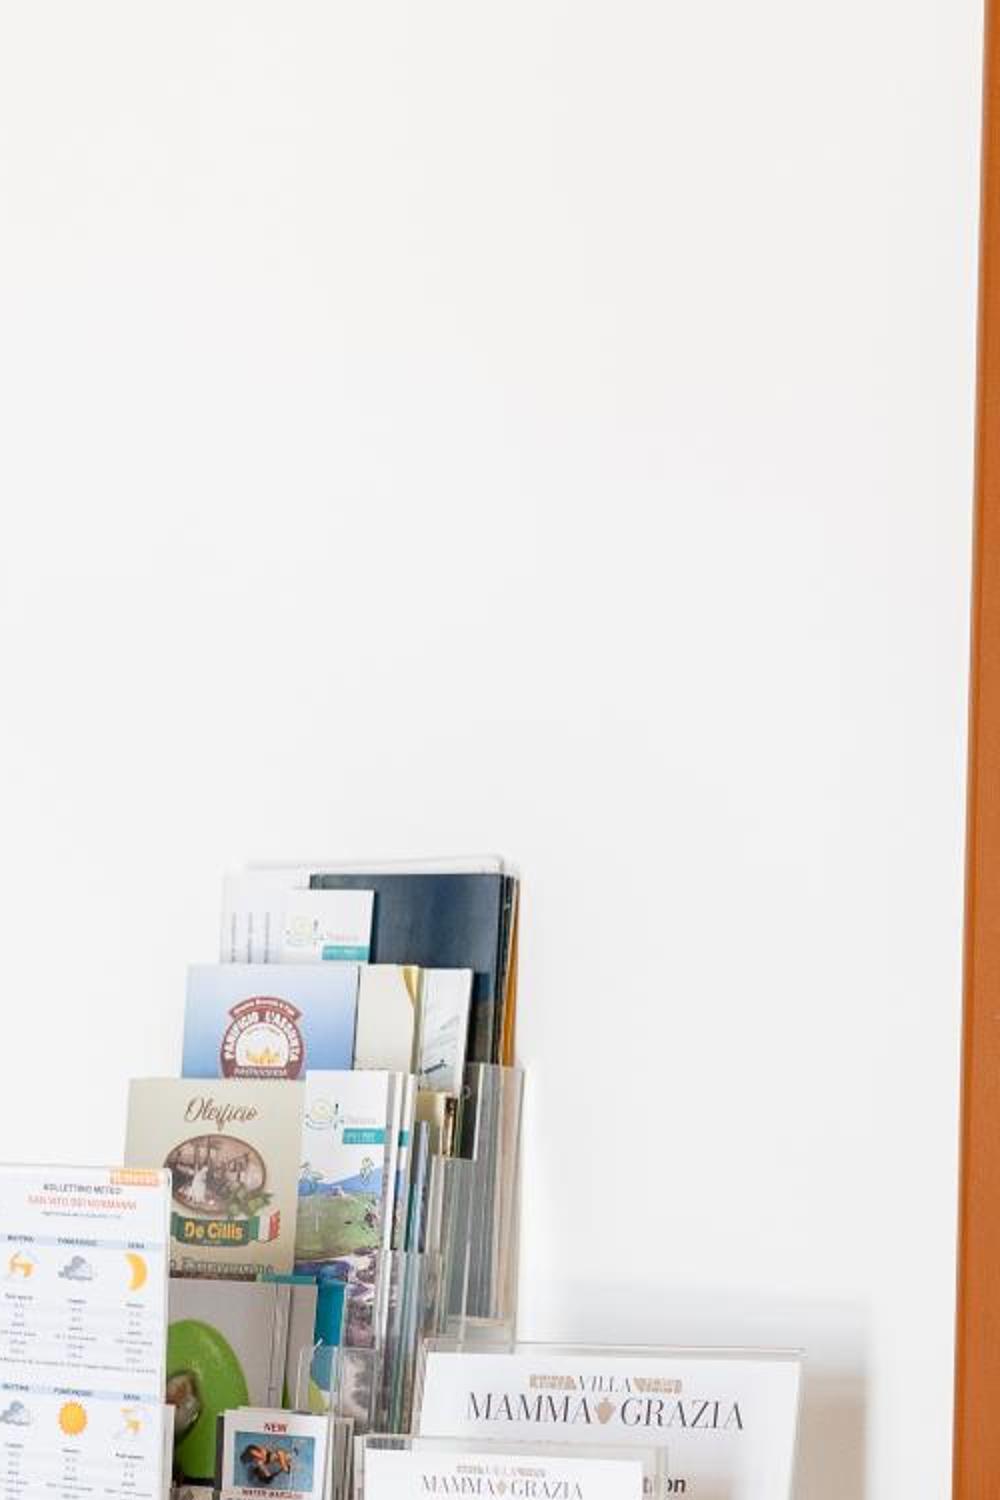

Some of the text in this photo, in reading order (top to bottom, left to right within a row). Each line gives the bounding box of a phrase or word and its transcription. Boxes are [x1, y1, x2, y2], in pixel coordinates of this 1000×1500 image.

[184, 1097, 259, 1132] Oleificio
[184, 1220, 206, 1238] De
[578, 1375, 632, 1393] VILLA
[467, 1392, 744, 1430] MAMMA GRAZIA
[263, 1422, 288, 1433] NEW
[422, 1474, 583, 1500] MAMMA GRAZIA
